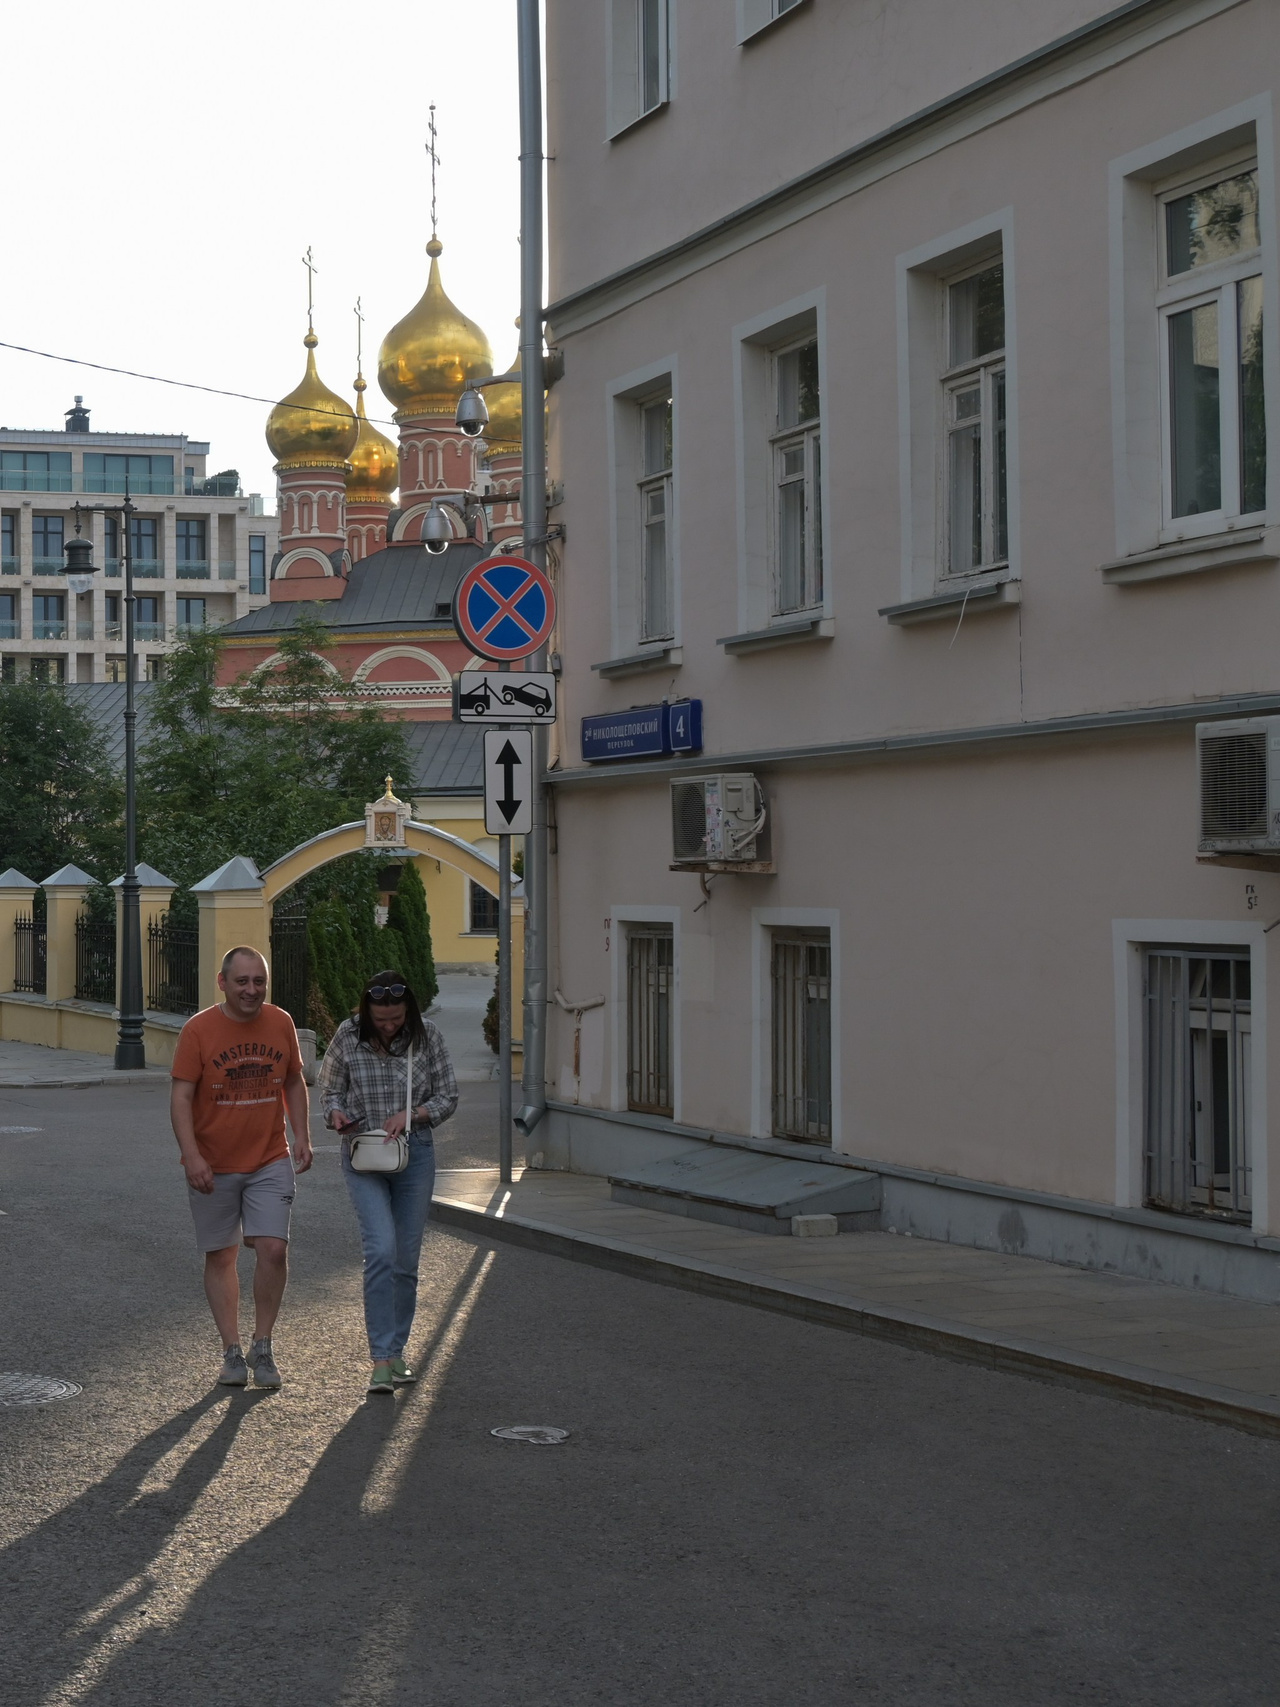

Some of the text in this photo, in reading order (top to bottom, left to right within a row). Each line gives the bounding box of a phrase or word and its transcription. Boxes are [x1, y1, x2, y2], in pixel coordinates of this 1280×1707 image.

[593, 718, 658, 741] НИКОЛОЩЕПОВСКИЙ
[676, 715, 685, 738] 4
[608, 740, 635, 749] ПЕРЕУЛОК
[212, 1042, 283, 1070] AMSTERDAM
[210, 1093, 230, 1101] LAND
[248, 1091, 261, 1099] THE
